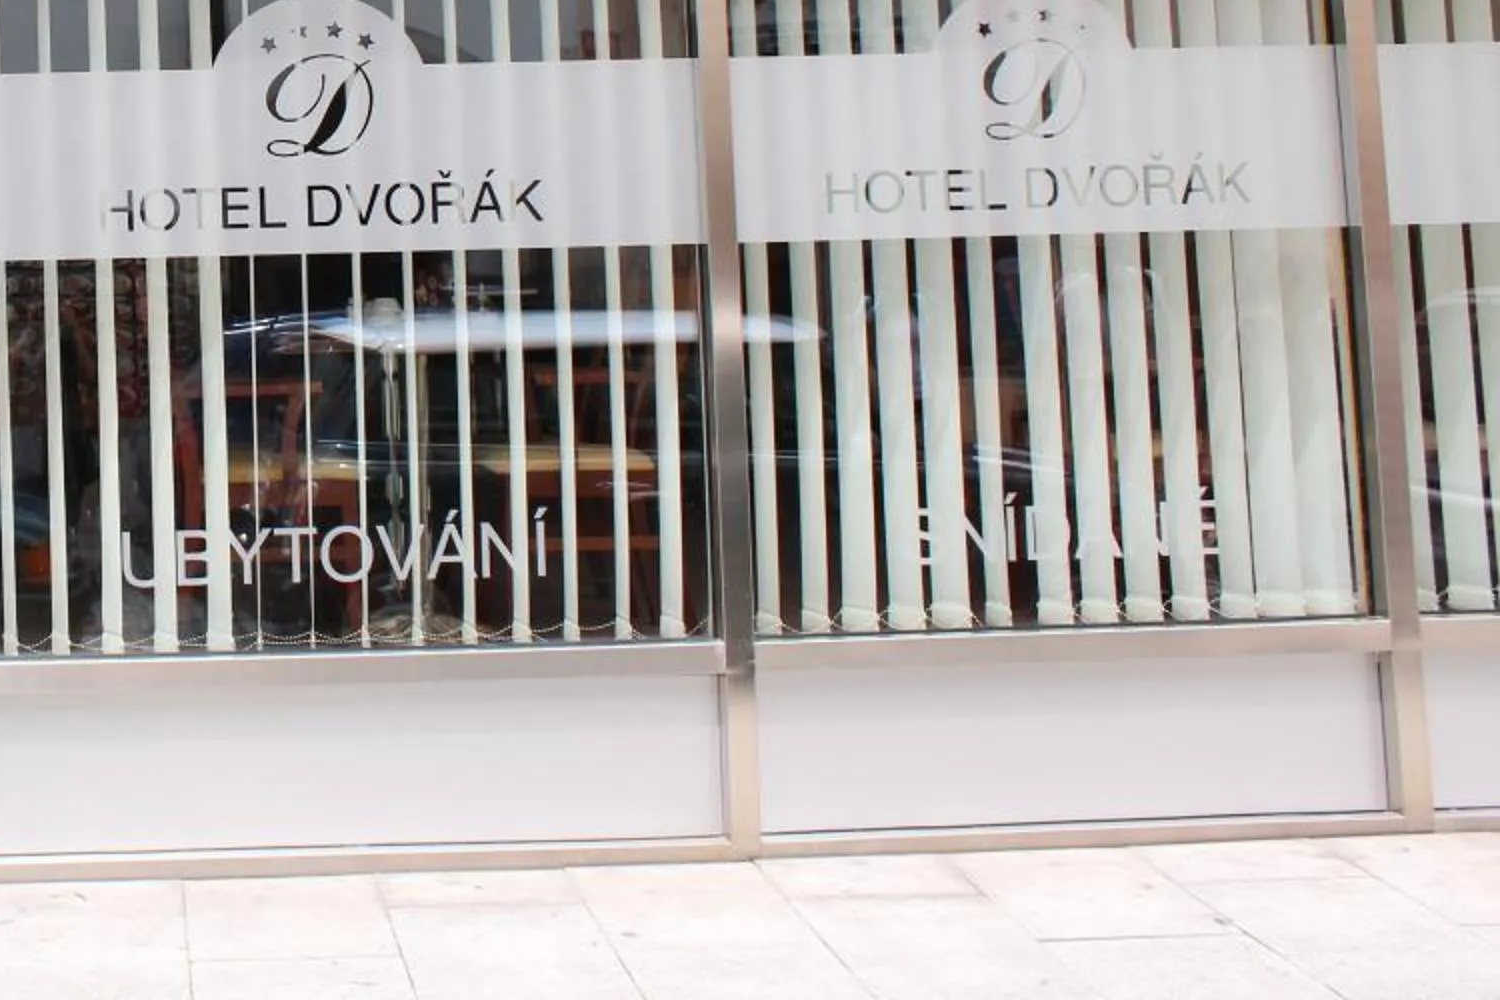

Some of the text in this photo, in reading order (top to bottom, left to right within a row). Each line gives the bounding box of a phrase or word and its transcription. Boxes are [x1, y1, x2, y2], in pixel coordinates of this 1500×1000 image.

[100, 168, 543, 232] HOTEL DVOŘÁK
[825, 152, 1251, 214] HOTEL DVOŘÁK
[121, 506, 549, 588] UBYTOVÁNÍ
